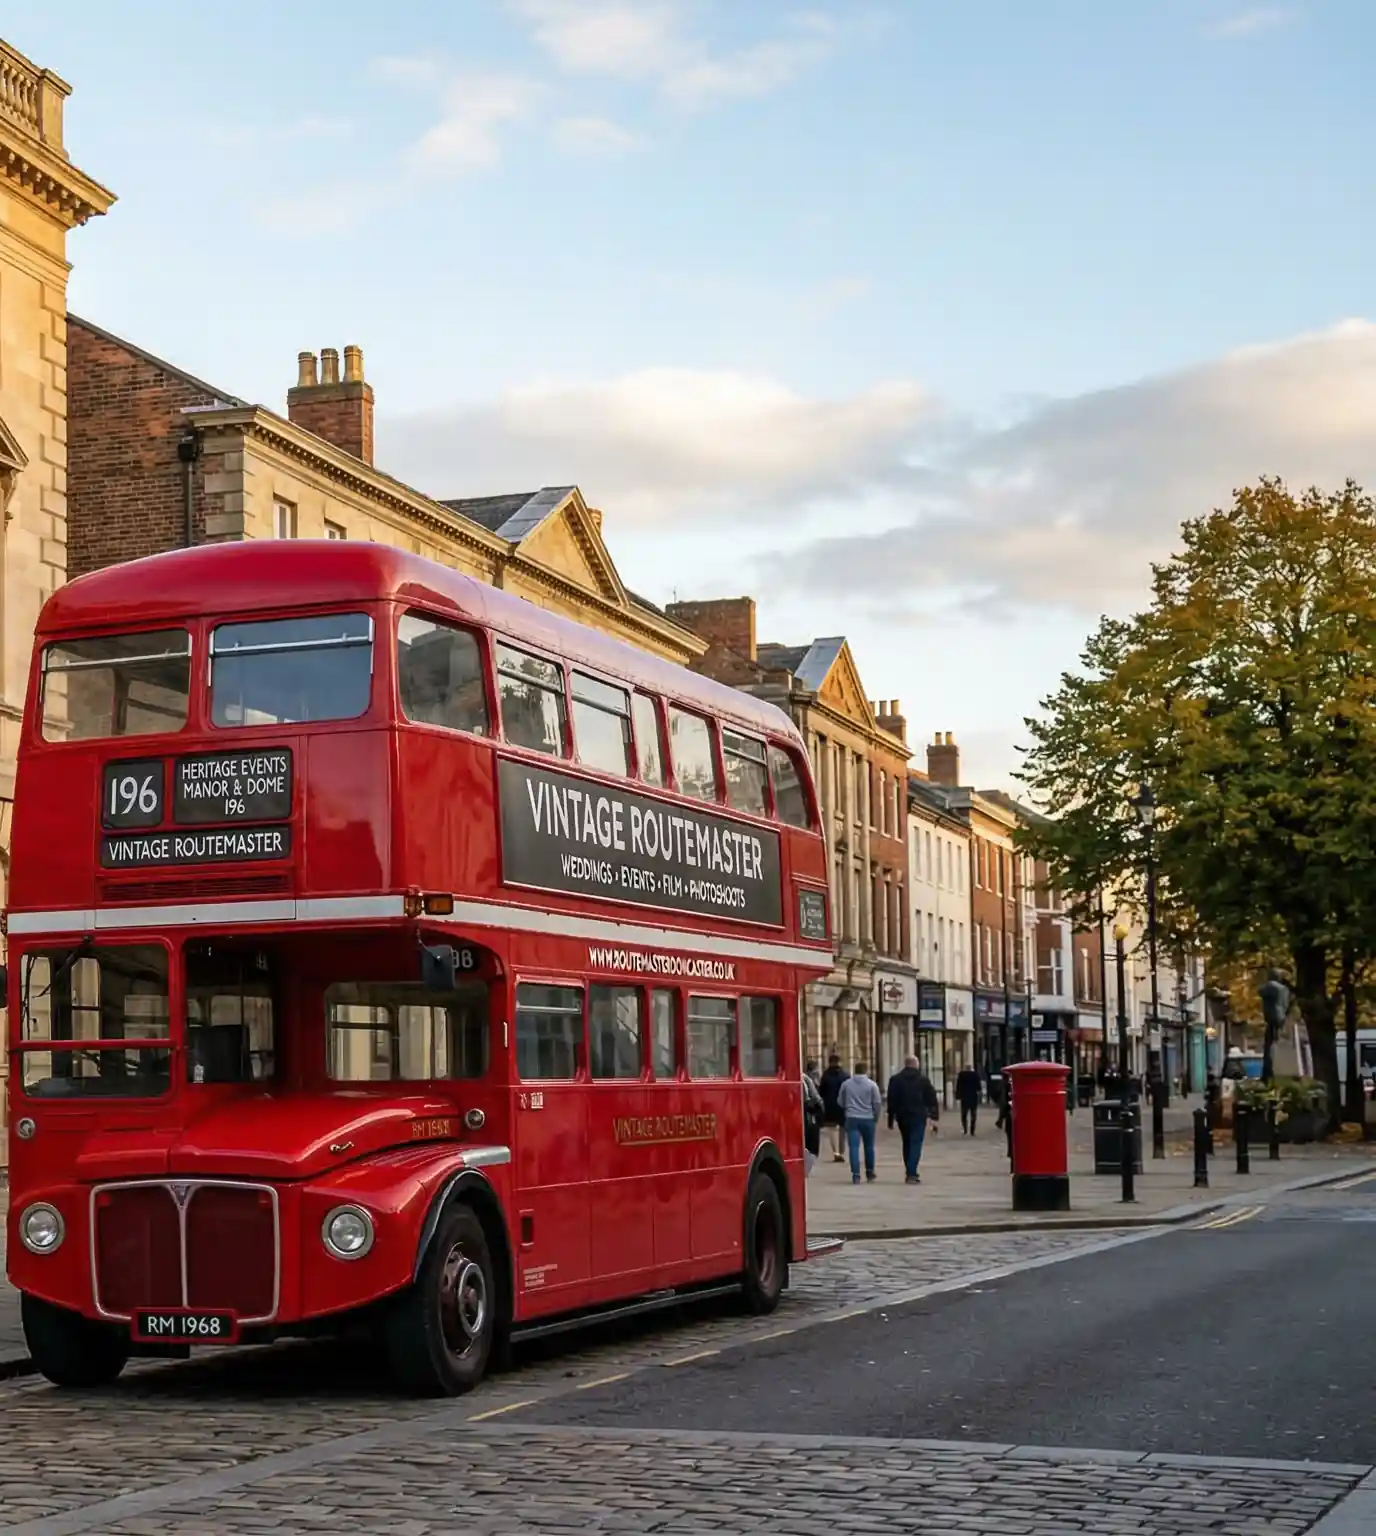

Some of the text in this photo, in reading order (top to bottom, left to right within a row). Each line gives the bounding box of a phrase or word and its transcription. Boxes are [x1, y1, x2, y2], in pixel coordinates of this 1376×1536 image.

[182, 756, 287, 780] HERITAGE EVENTS
[110, 775, 158, 815] 196
[183, 776, 285, 799] MANOR & DOME
[224, 798, 246, 816] 196
[526, 778, 764, 880] VINTAGE ROUTEMASTER
[108, 832, 283, 861] VINTAGE ROUTEMASTER
[560, 853, 746, 908] WEDDINGS EVENTS FILM PHOTOSHOOTS
[147, 1315, 221, 1335] RM 1968
